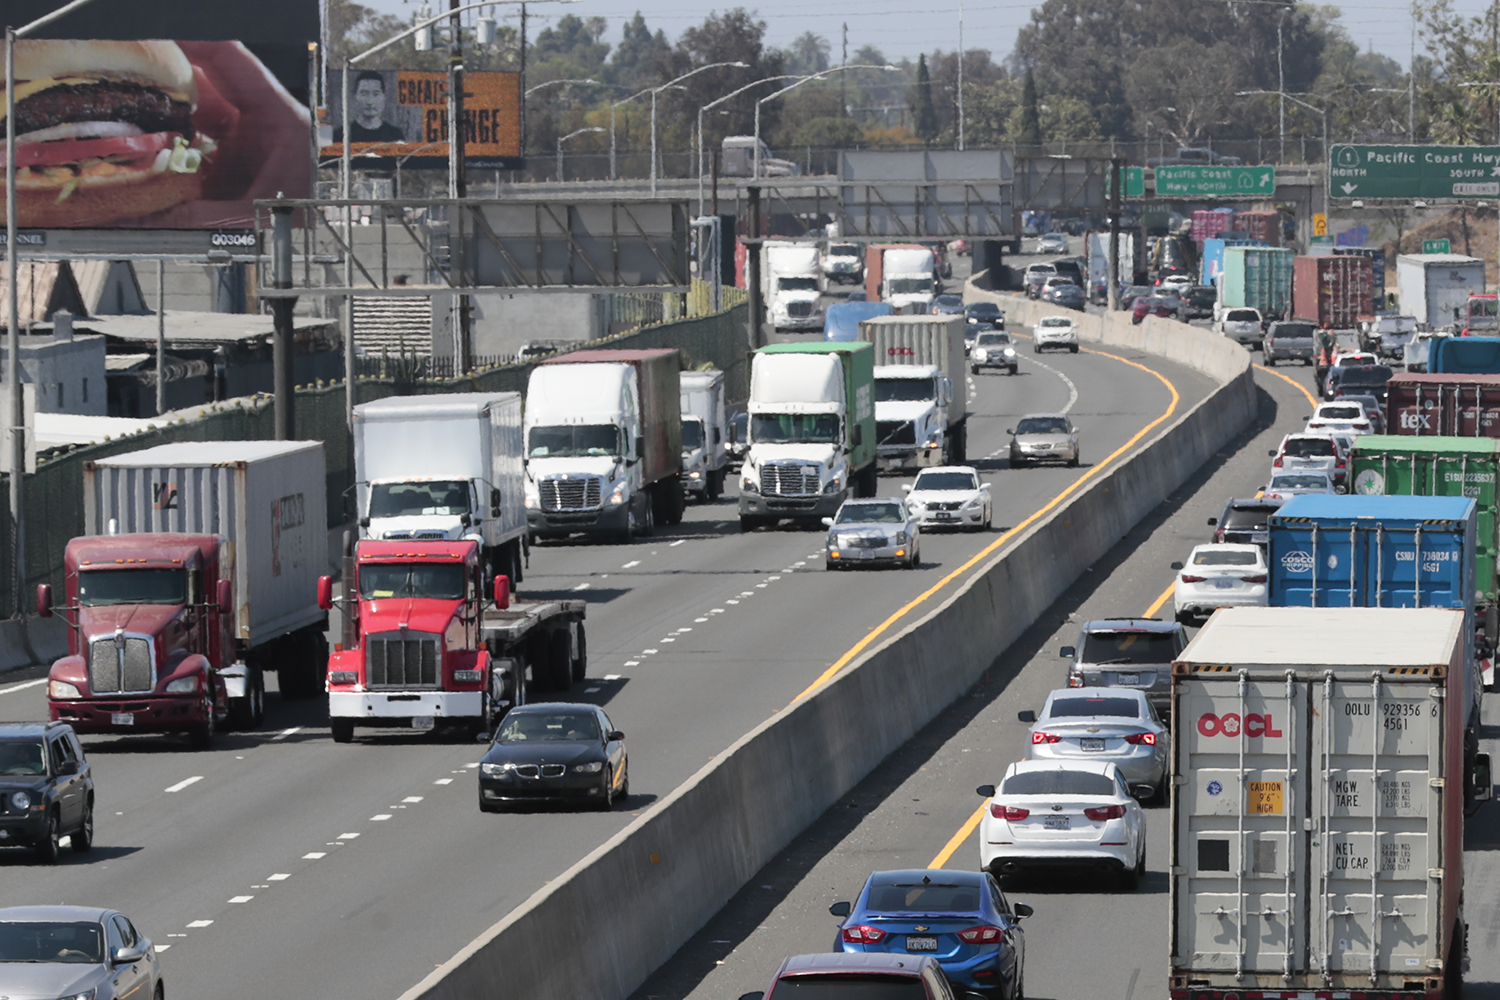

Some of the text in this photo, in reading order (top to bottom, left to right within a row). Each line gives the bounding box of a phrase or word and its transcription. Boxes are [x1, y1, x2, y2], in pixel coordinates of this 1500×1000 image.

[427, 109, 500, 143] CHNGE
[1367, 151, 1416, 163] Pacific
[1425, 152, 1464, 164] Coast
[1332, 168, 1367, 177] NORTH
[1450, 169, 1484, 178] SOUTH
[1400, 410, 1432, 429] tex
[1281, 556, 1314, 564] COSCO
[1395, 551, 1415, 561] CSNU
[1422, 563, 1440, 572] 45G1
[1345, 703, 1437, 717] OOLU 929356 6
[1197, 713, 1282, 737] OOCL
[1384, 718, 1408, 731] 45G1
[1250, 783, 1281, 792] CAUTION
[1336, 781, 1359, 793] MGW.
[1336, 795, 1361, 807] TARE.
[1257, 804, 1273, 813] HIGH
